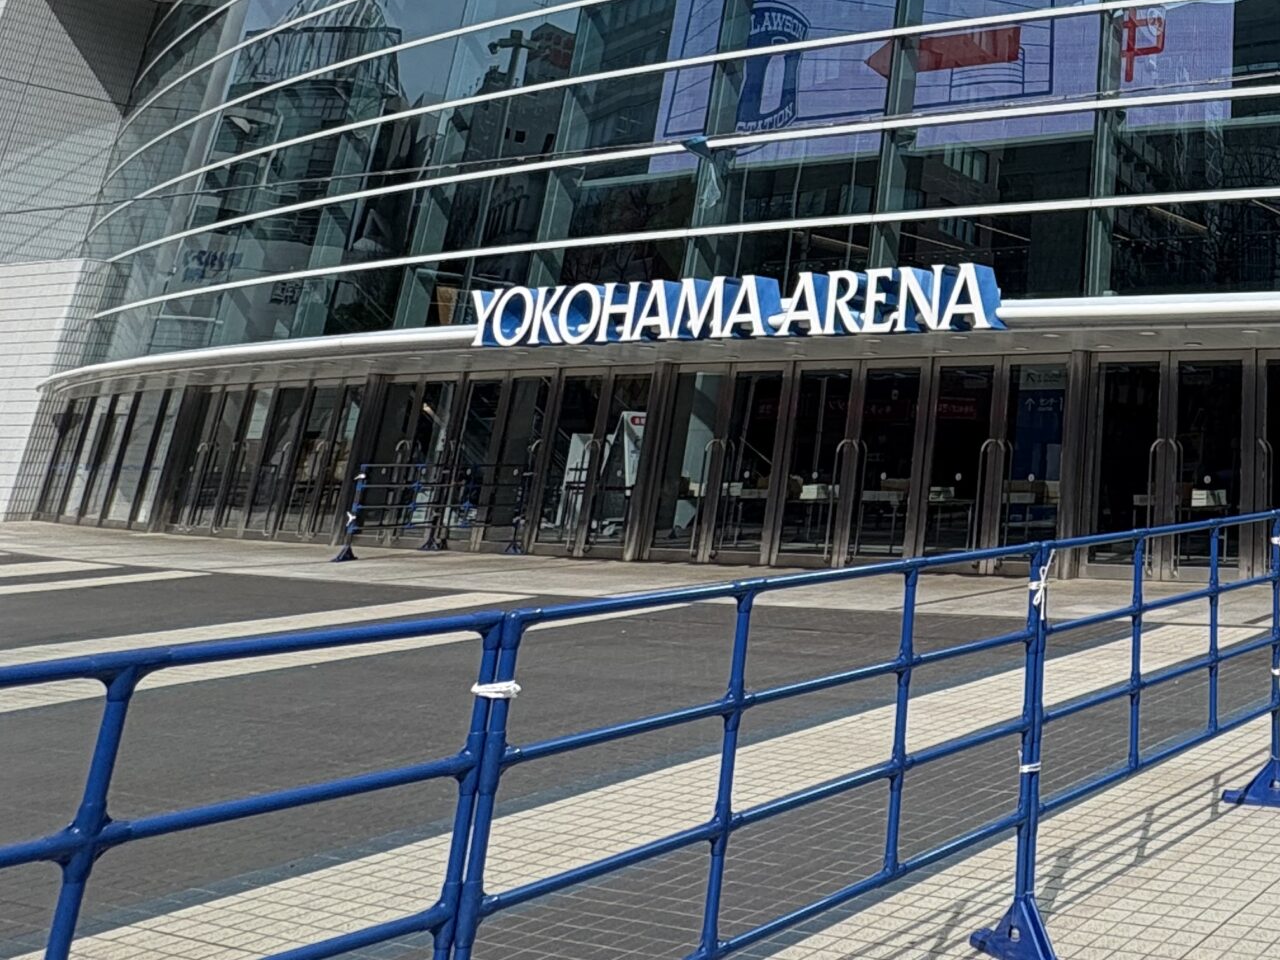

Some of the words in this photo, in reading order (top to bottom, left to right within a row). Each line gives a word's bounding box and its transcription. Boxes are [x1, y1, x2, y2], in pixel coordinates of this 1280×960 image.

[749, 12, 806, 41] LAWSON
[471, 274, 768, 346] YOKOHAMA
[777, 262, 993, 335] ARENA
